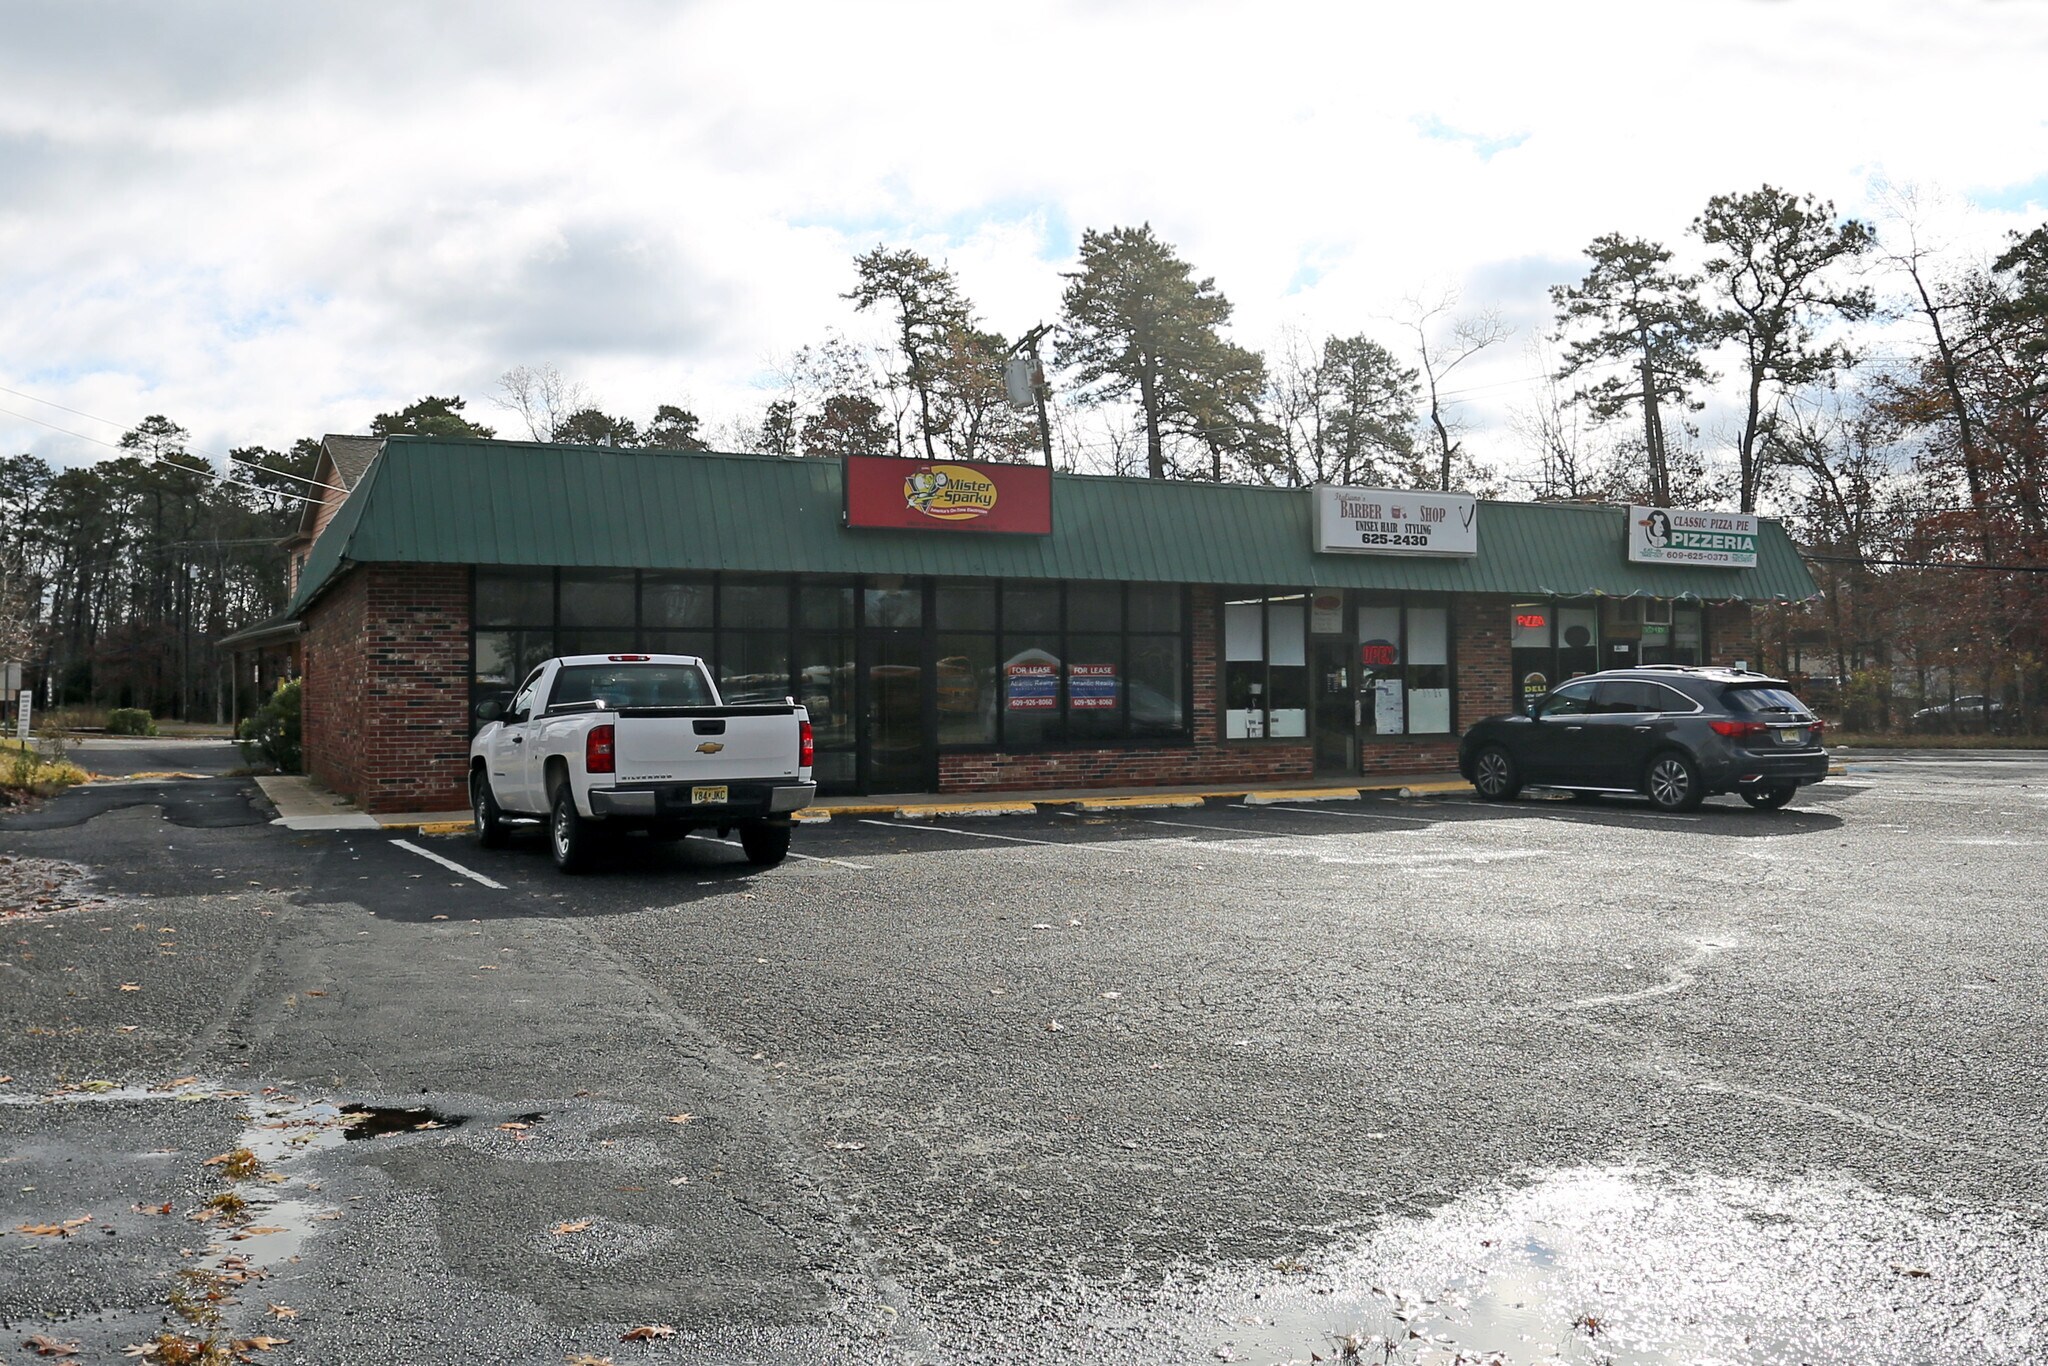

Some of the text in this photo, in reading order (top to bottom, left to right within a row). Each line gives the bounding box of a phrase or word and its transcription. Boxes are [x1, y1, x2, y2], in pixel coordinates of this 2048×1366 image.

[947, 479, 992, 492] Mister
[944, 491, 992, 506] Sparky
[1340, 501, 1446, 523] BARBER SHOP
[1355, 521, 1431, 535] UNISEX HAIR STYLING
[1673, 516, 1749, 531] CLASSIC PIZZA PIE
[1361, 533, 1428, 546] 625-2430
[1671, 532, 1754, 550] PIZZERIA
[1666, 551, 1729, 561] 609-625-0373
[1012, 666, 1051, 674] FOR LEASE
[1524, 685, 1547, 693] DELI
